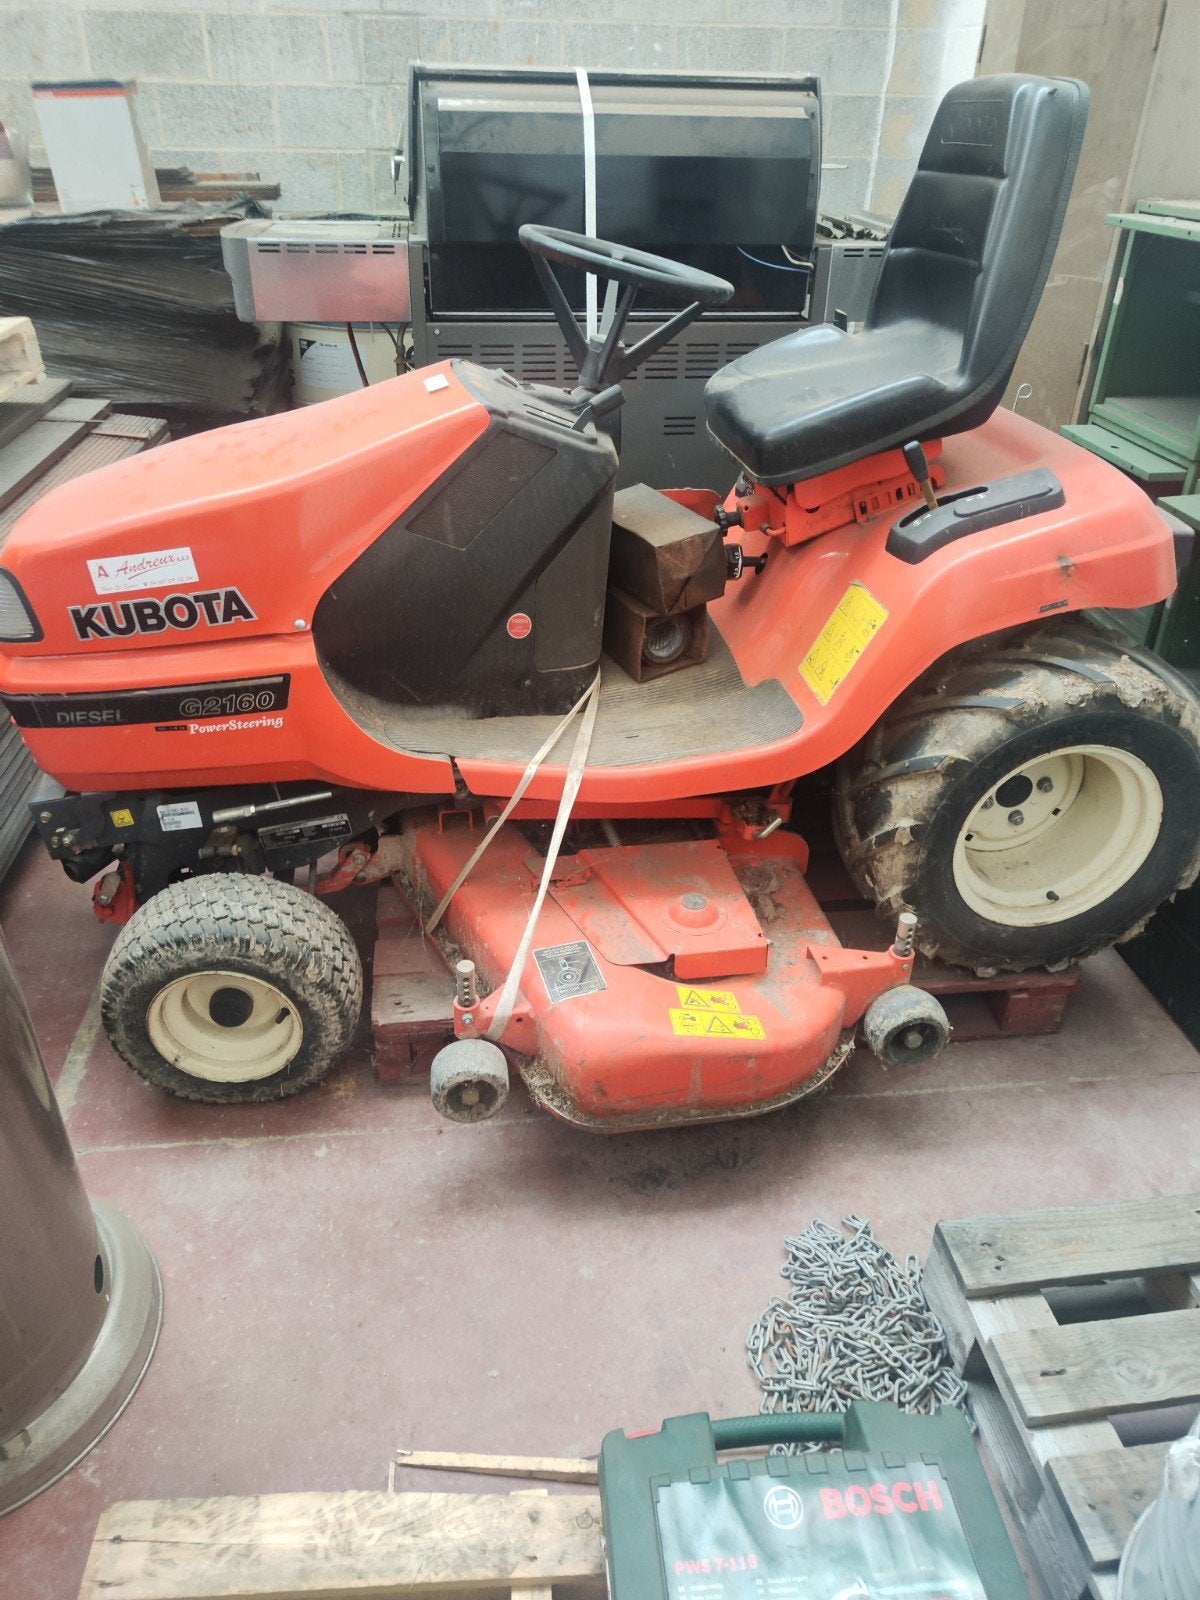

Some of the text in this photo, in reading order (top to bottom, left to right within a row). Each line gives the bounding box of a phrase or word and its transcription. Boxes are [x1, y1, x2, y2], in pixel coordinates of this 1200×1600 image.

[97, 565, 110, 579] A
[68, 588, 257, 640] KUBOTA
[56, 691, 276, 725] DIESEL G2160
[188, 716, 284, 735] PowerSteering
[819, 1480, 944, 1521] BOSCH
[674, 1557, 712, 1575] PWS
